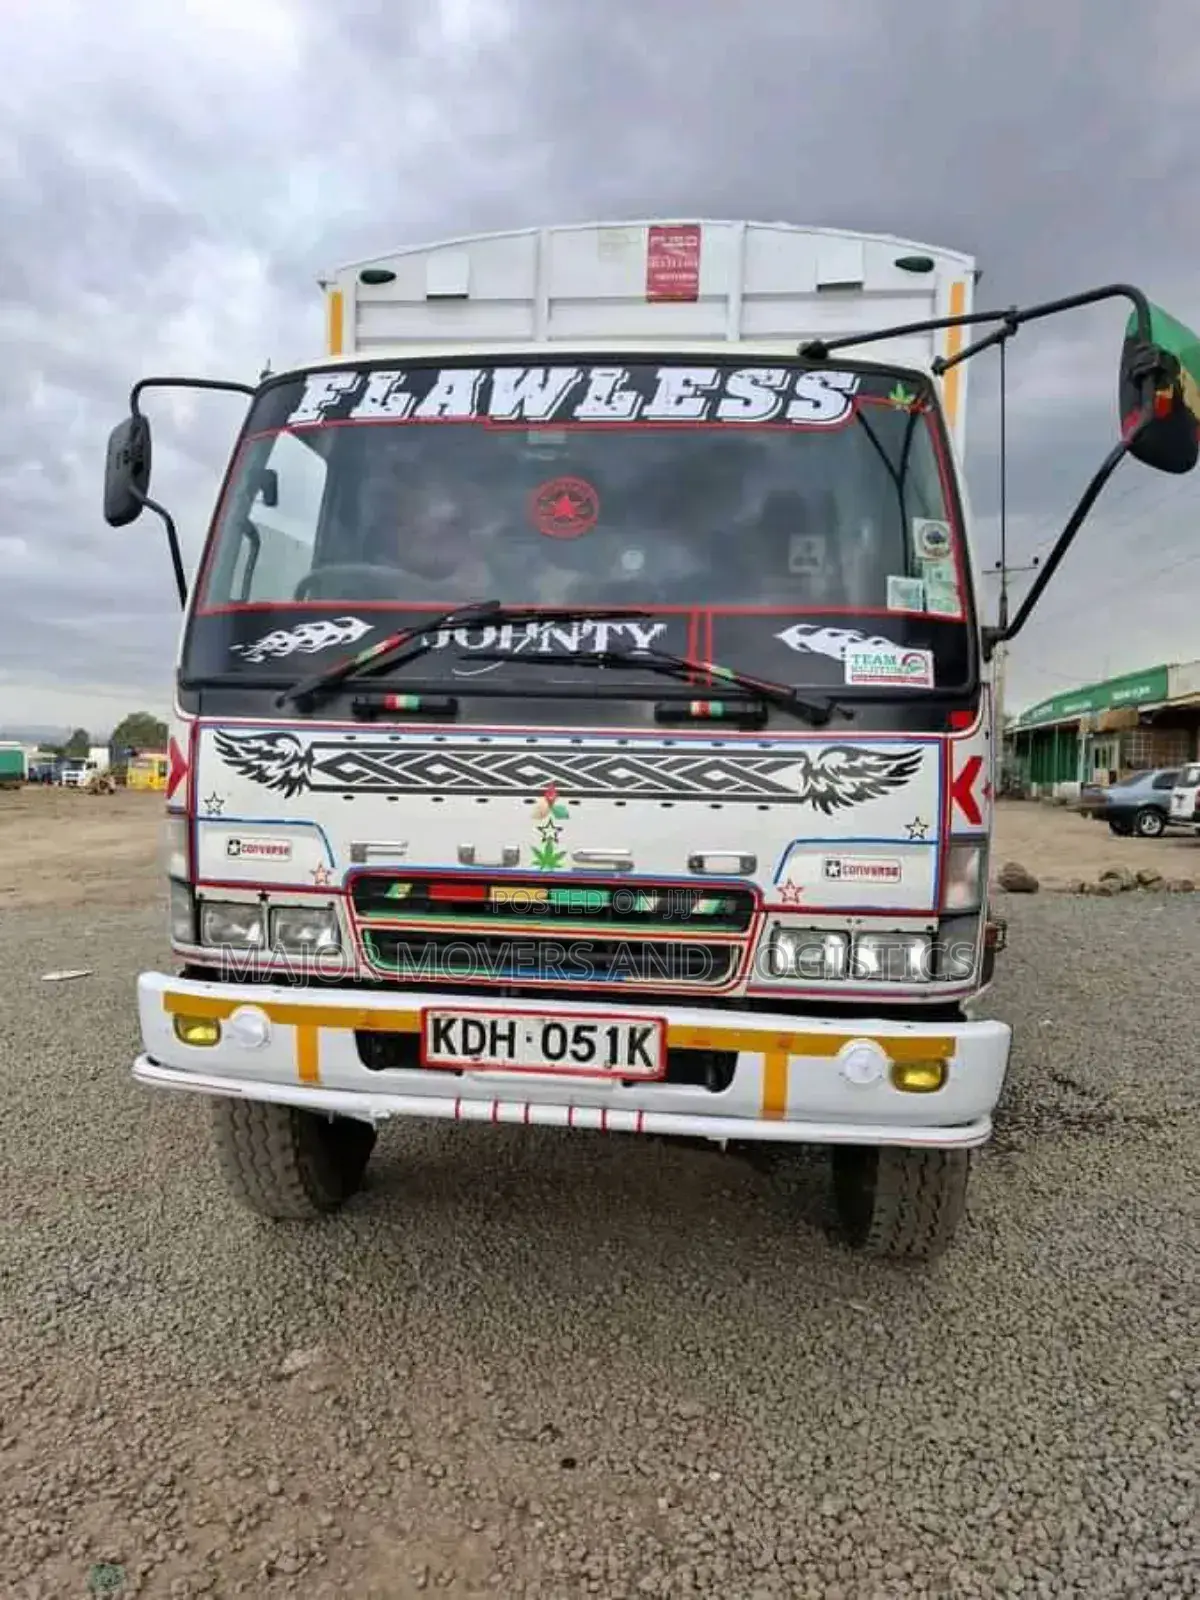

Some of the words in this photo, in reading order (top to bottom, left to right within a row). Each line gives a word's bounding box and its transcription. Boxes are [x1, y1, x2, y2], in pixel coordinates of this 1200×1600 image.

[287, 367, 861, 427] FLAWLESS
[421, 616, 667, 655] JOHNTY
[852, 653, 897, 666] TEAM
[350, 840, 758, 876] FUSO
[431, 1018, 516, 1058] KDH
[541, 1022, 654, 1068] 051K
